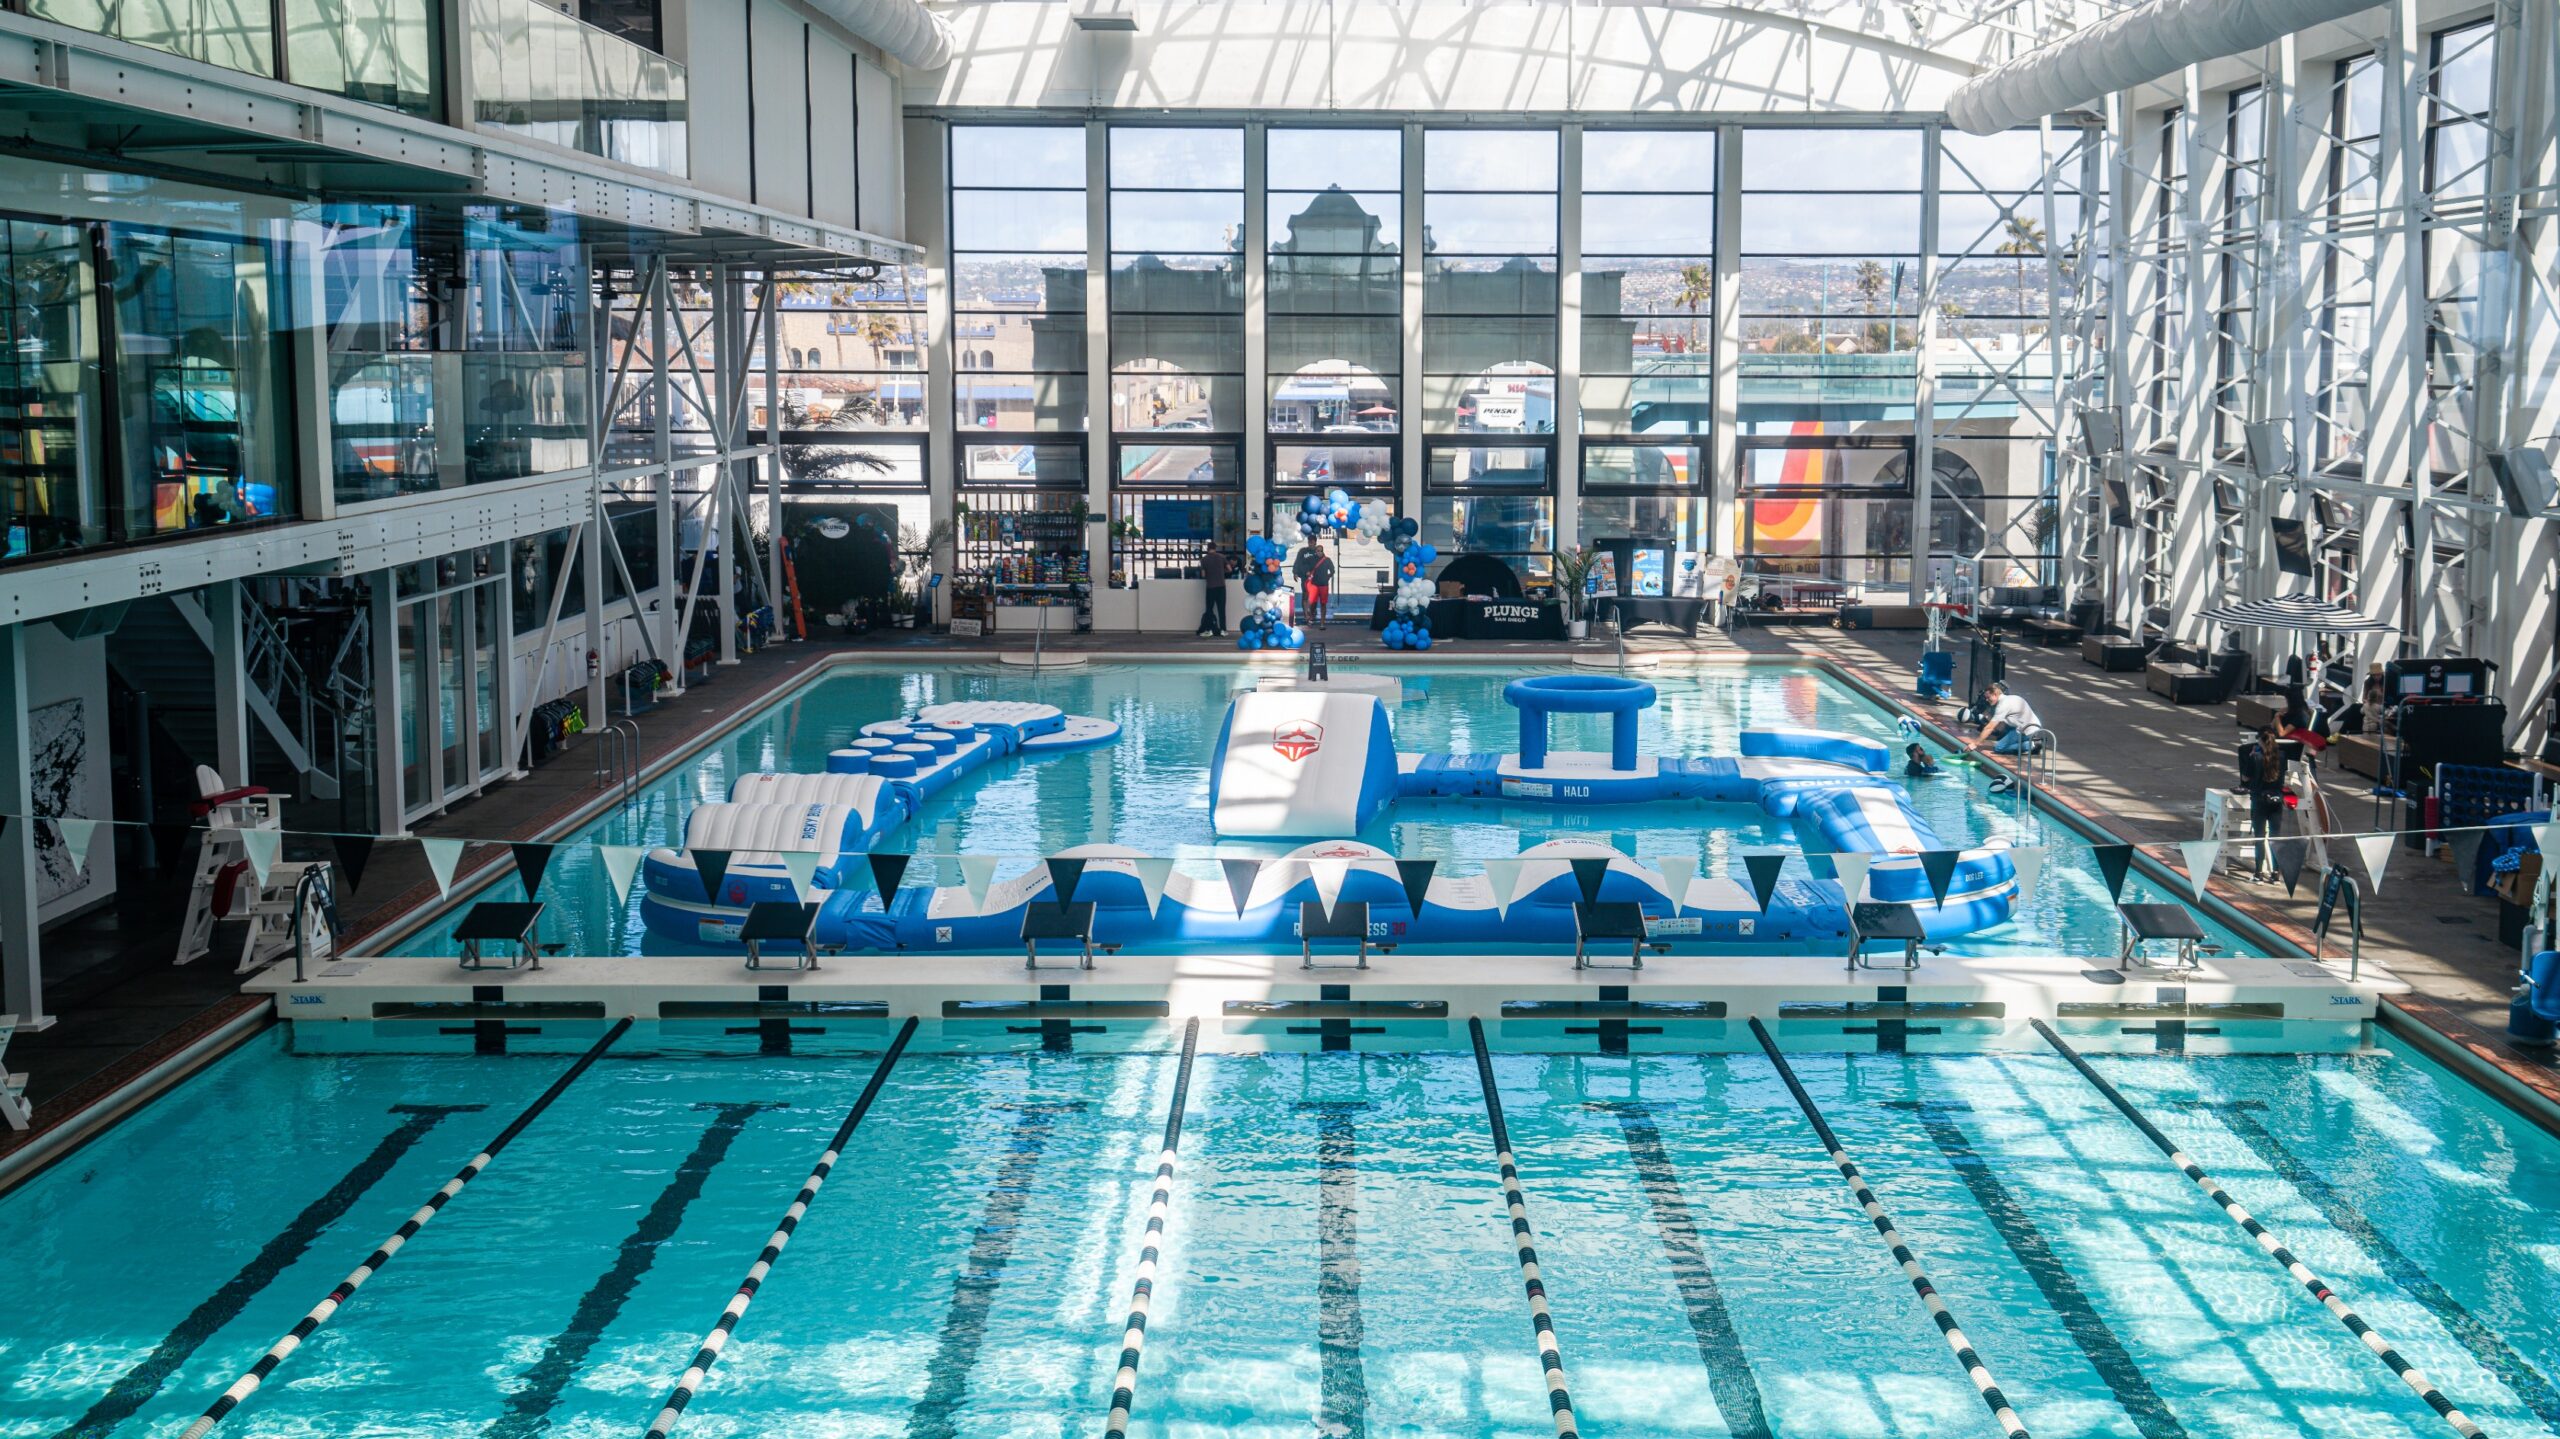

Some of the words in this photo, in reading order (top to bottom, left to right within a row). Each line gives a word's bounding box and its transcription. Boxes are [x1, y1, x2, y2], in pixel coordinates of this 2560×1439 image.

[1483, 605, 1539, 618] PLUNGE
[1564, 786, 1589, 797] HALO
[802, 818, 820, 839] RISKY
[292, 995, 323, 1004] STARK
[2332, 996, 2362, 1004] STARK
